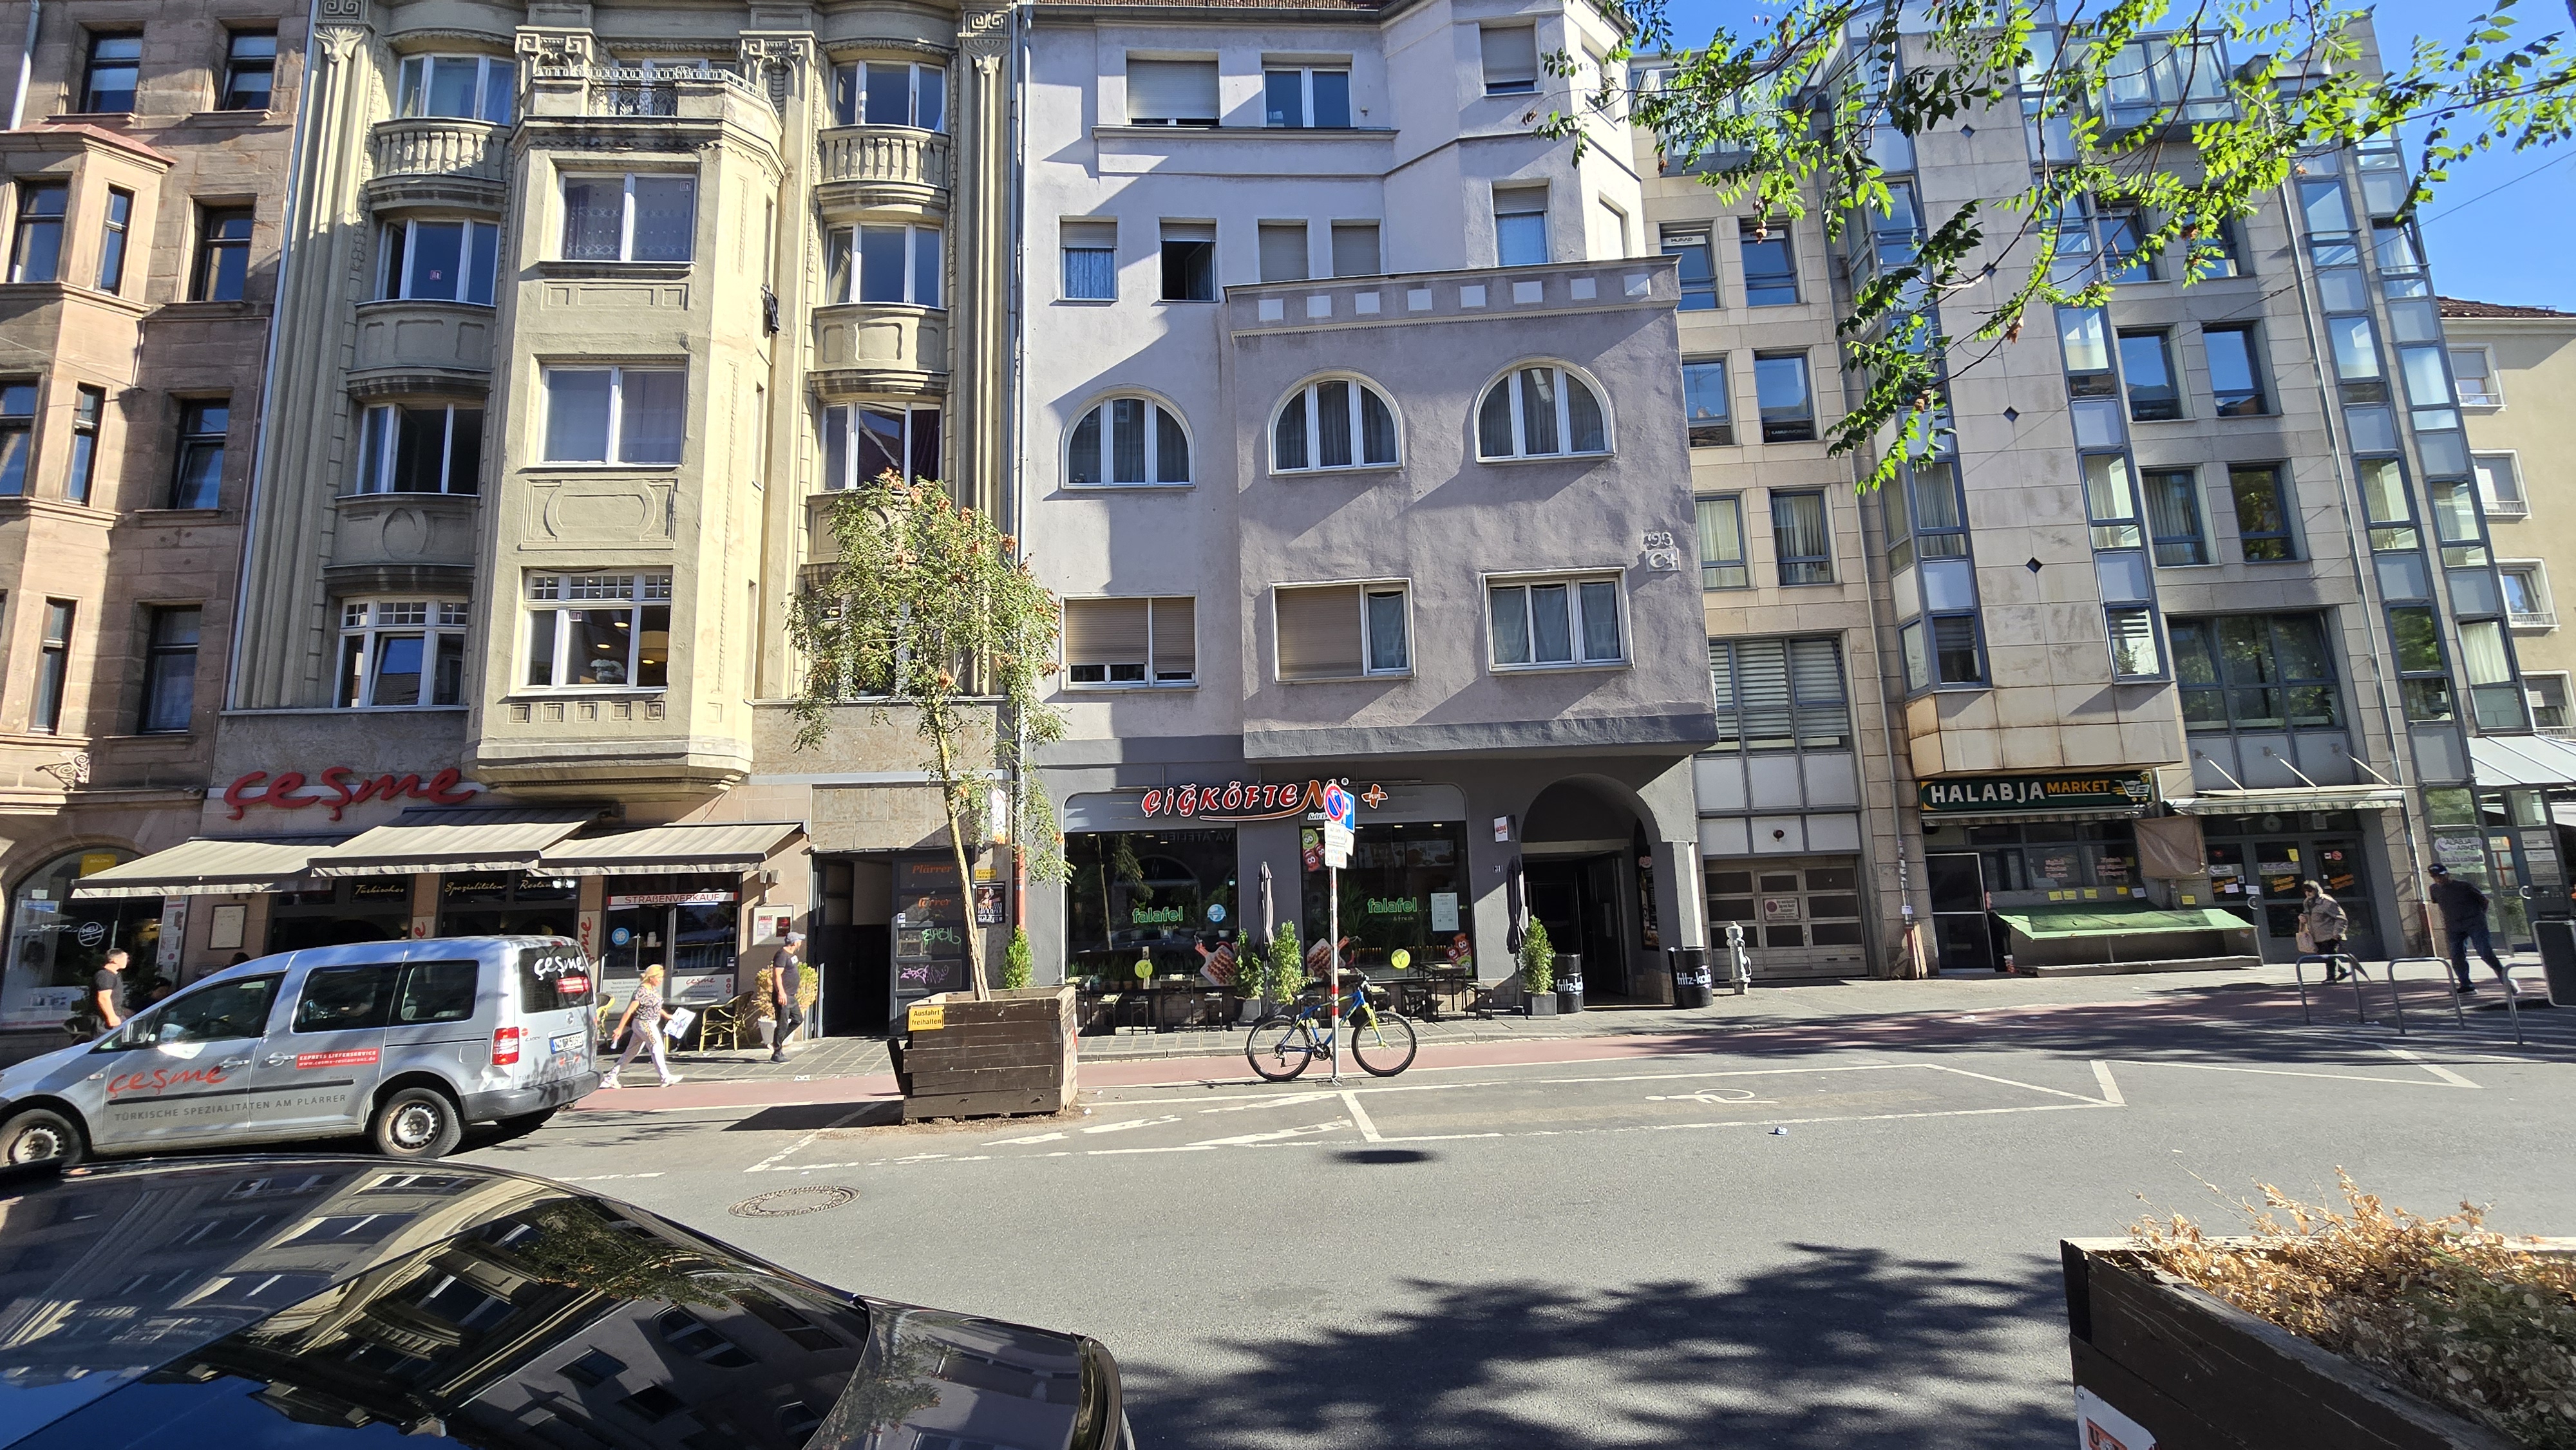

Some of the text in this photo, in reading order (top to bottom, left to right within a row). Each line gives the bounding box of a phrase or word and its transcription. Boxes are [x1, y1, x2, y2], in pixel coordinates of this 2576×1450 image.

[223, 766, 477, 821] çeşme
[1931, 782, 2045, 804] HALABJA
[2047, 780, 2110, 794] MARKET
[911, 863, 952, 874] Plärrer
[444, 881, 507, 896] Spezialitäten
[1367, 897, 1417, 913] falafel
[1132, 906, 1184, 923] falafel
[534, 956, 585, 981] çeşme
[328, 1050, 377, 1059] LIEFERSERVICE
[108, 1066, 229, 1098] çeşme
[115, 1108, 179, 1122] TÜRKISCHE
[275, 1097, 292, 1107] AM
